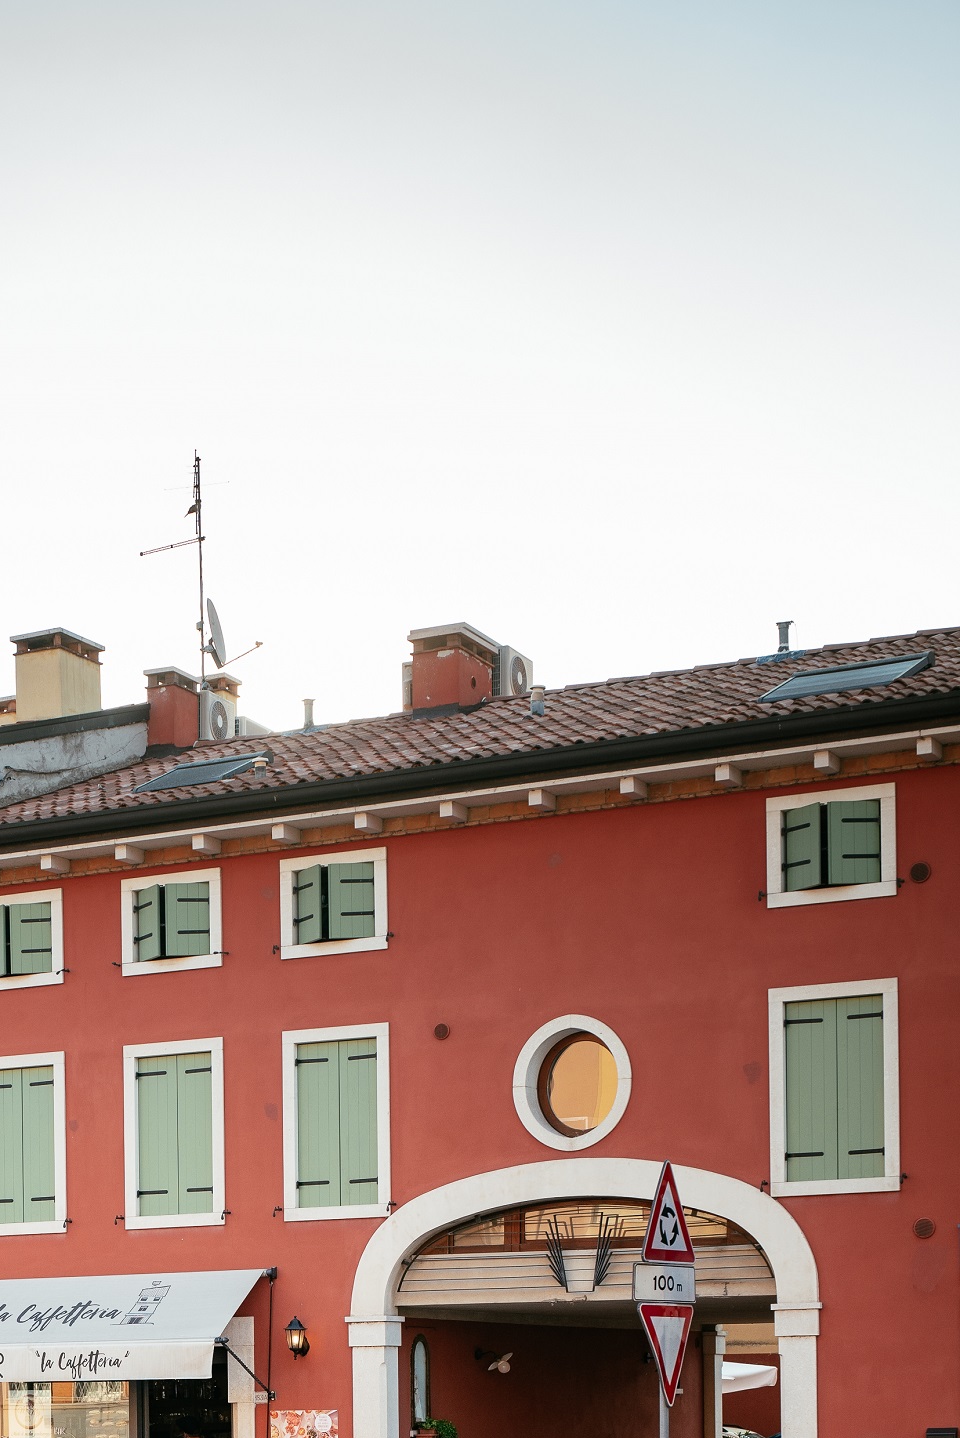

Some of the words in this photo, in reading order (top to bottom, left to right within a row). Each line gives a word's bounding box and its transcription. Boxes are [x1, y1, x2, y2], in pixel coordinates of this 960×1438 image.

[652, 1275, 675, 1292] 100
[676, 1283, 683, 1292] m
[16, 1300, 123, 1333] Caffetteria
